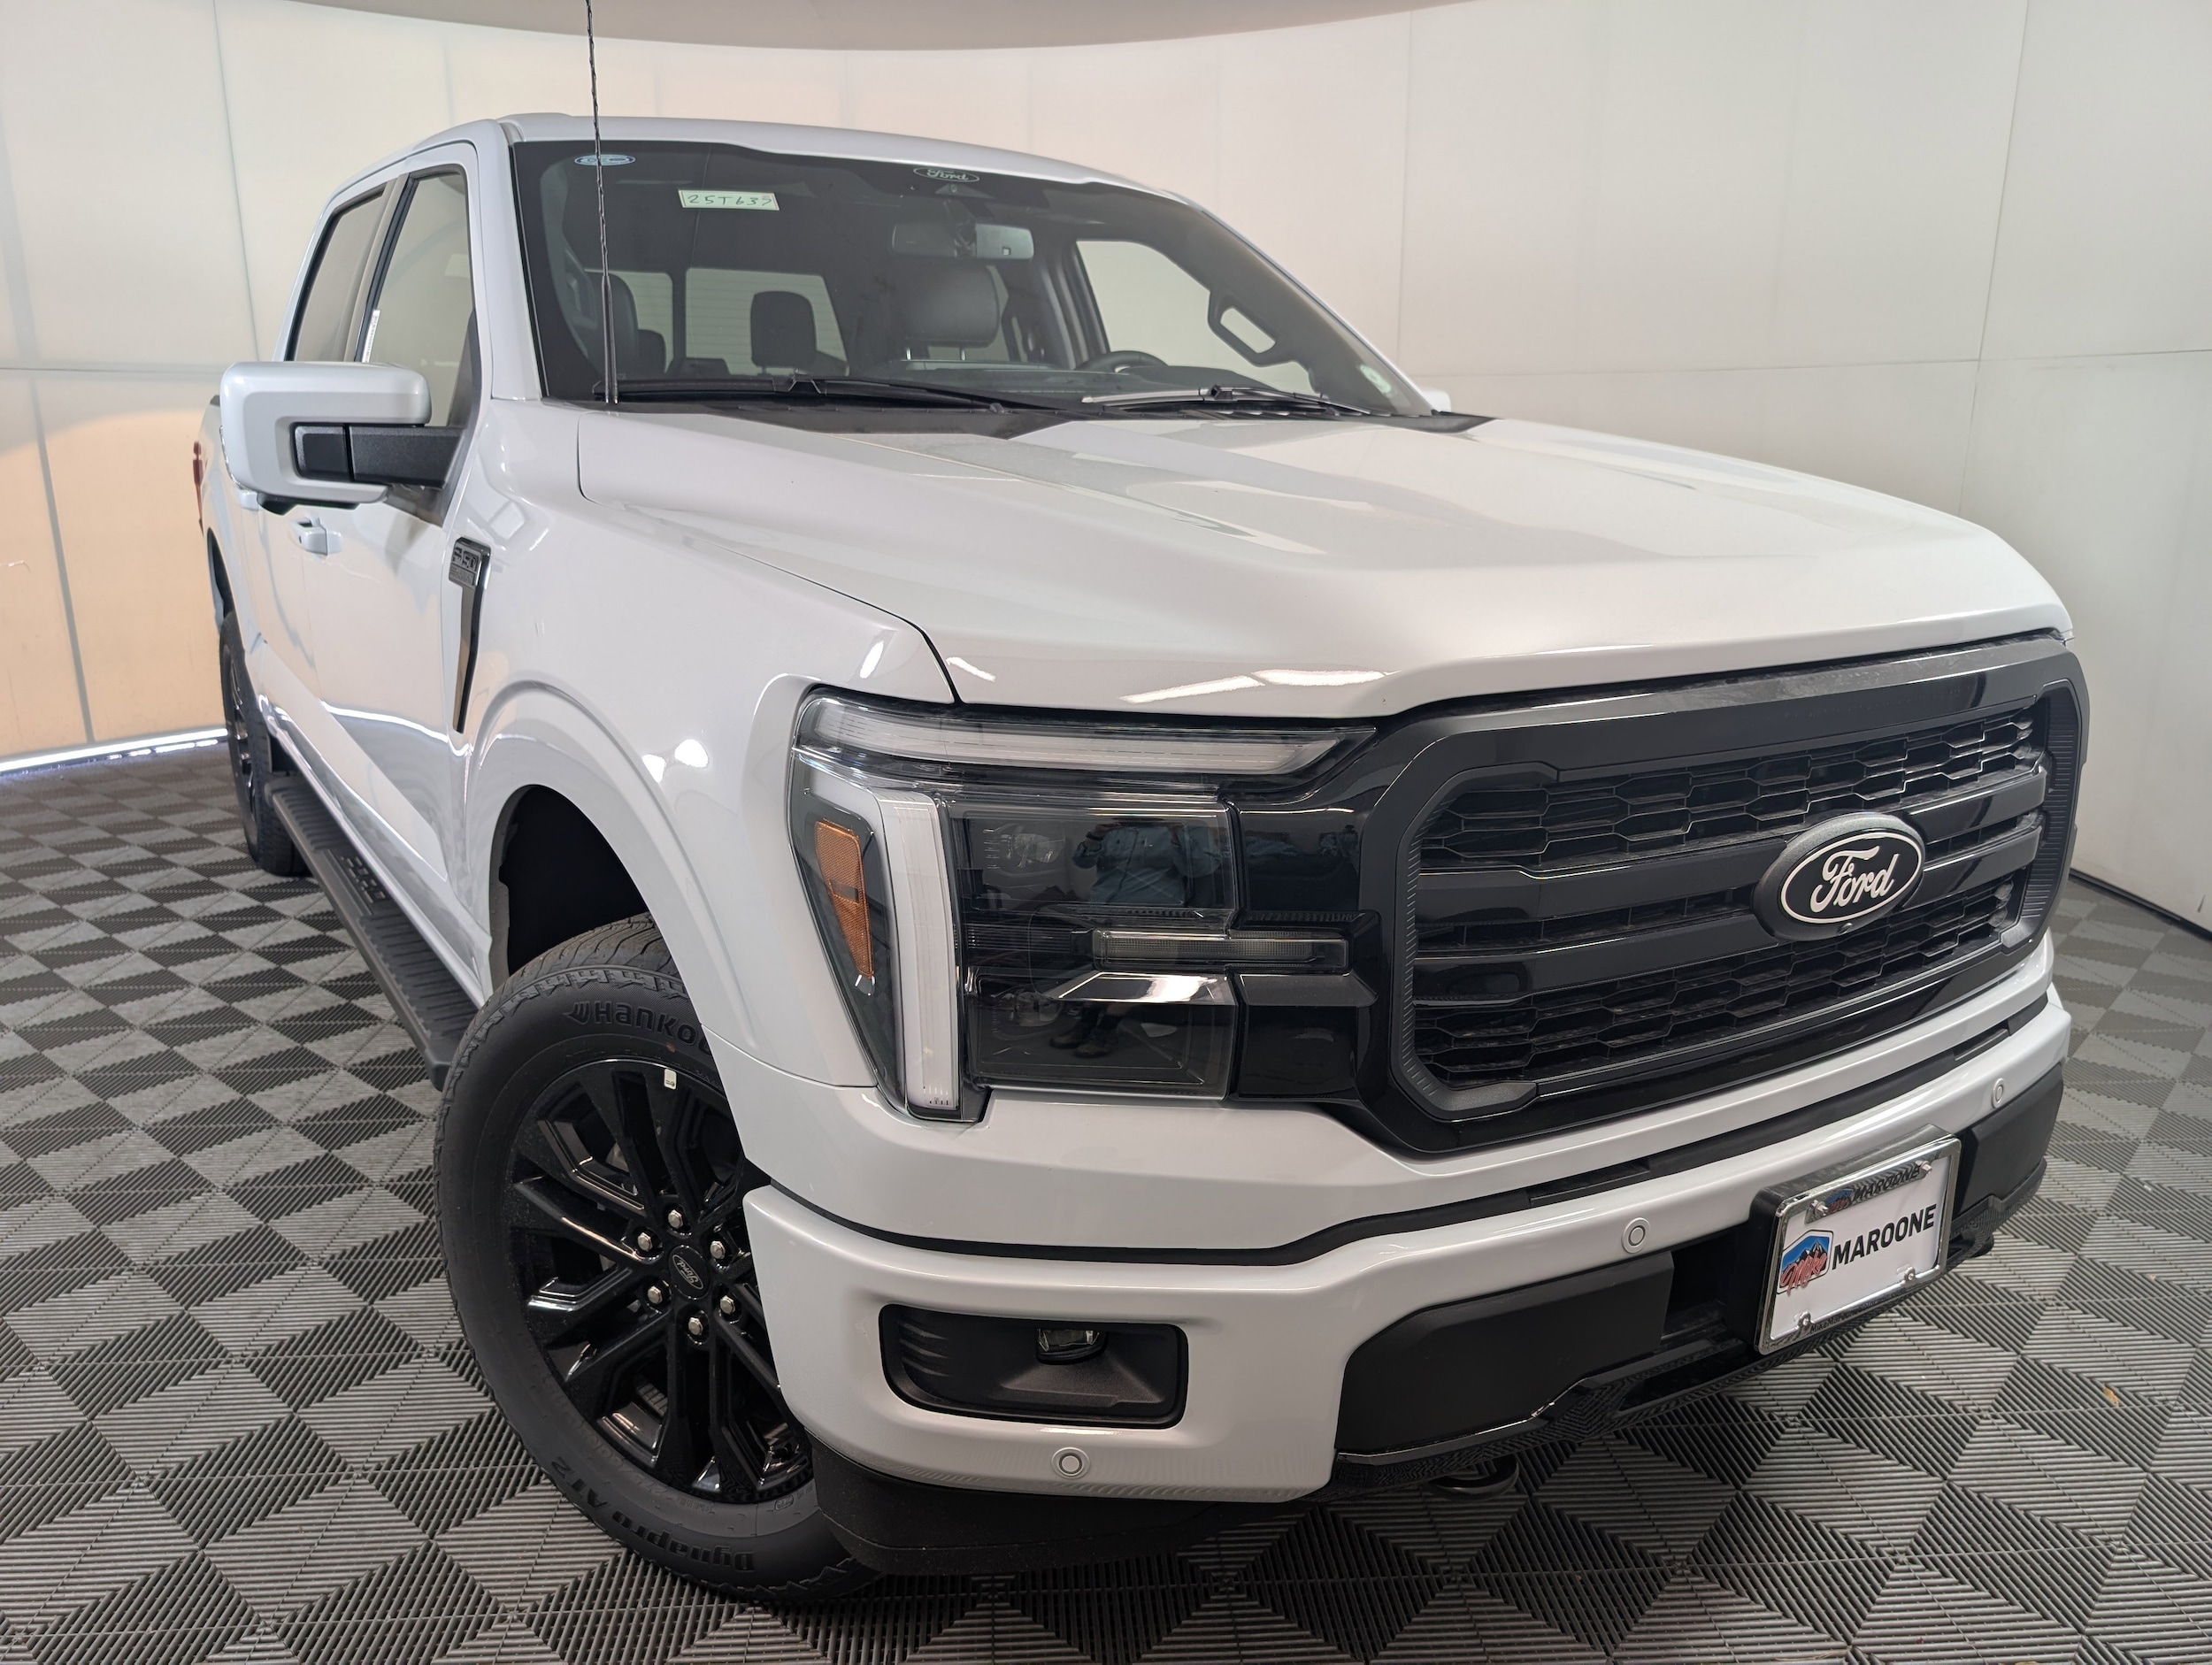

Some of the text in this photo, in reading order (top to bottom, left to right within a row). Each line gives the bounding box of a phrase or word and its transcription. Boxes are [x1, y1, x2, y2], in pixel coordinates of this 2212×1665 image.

[926, 169, 970, 181] Ford
[1810, 845, 1900, 913] Ford
[1853, 1165, 1921, 1201] MAROONE
[1832, 1203, 1937, 1270] MAROONE
[550, 1456, 755, 1572] Dynapro AT2
